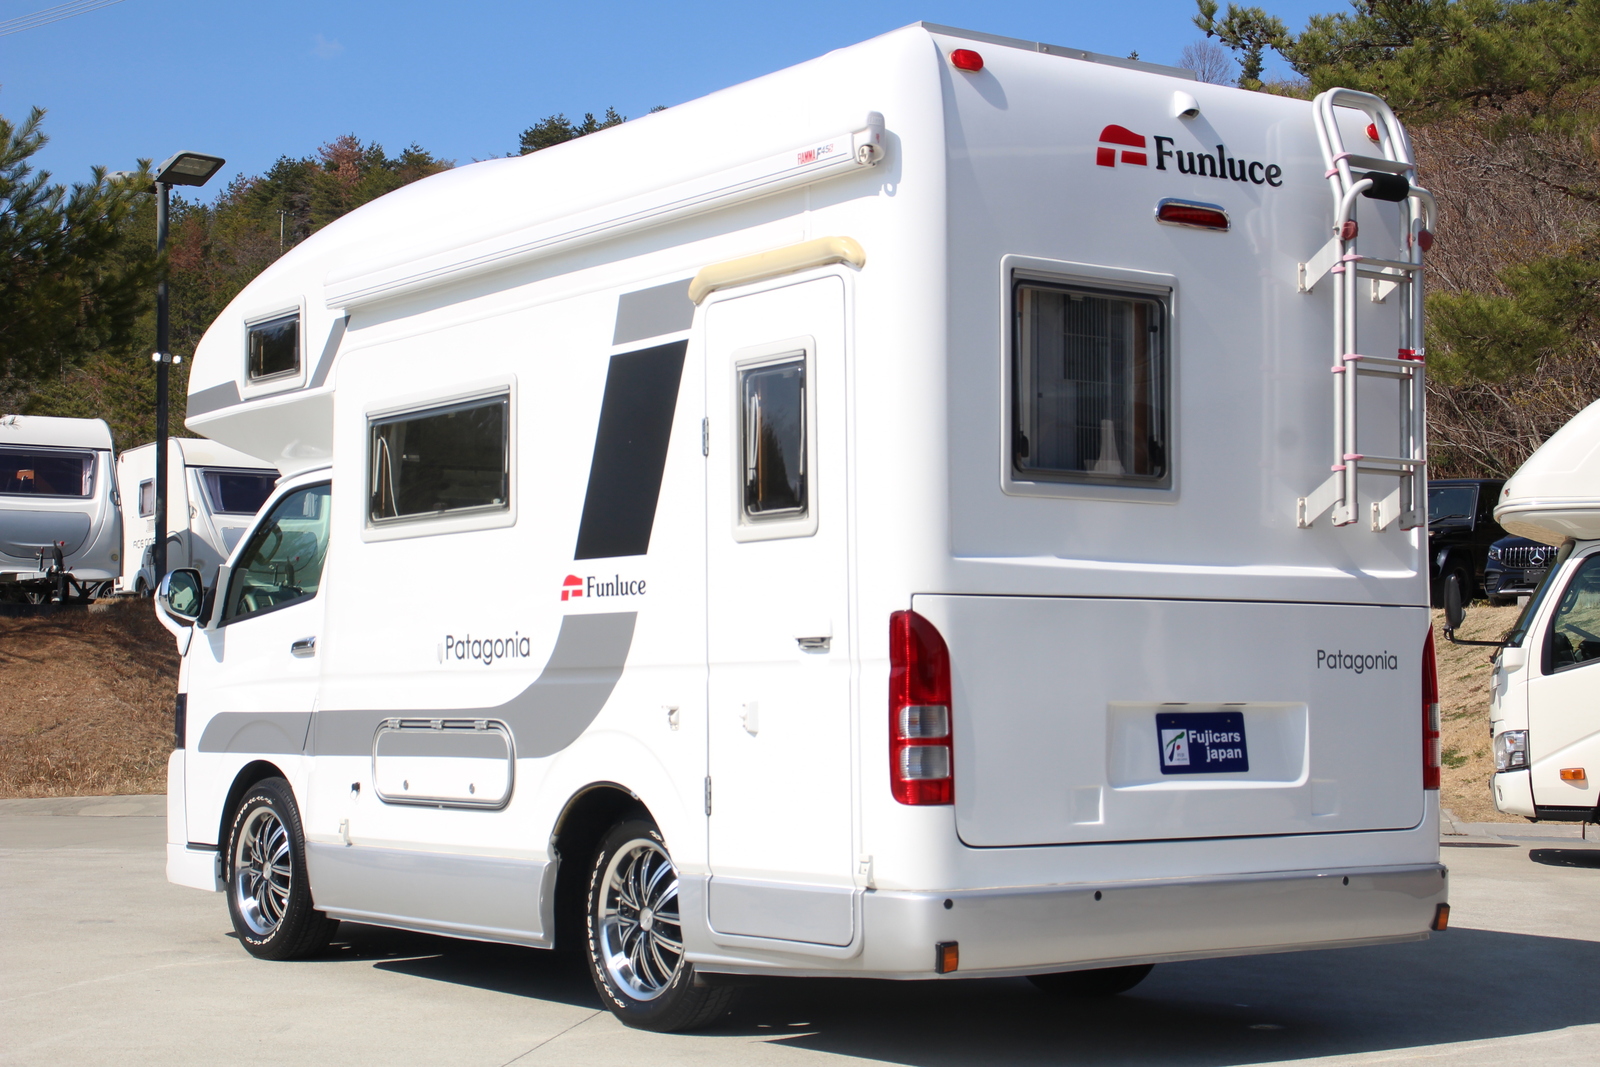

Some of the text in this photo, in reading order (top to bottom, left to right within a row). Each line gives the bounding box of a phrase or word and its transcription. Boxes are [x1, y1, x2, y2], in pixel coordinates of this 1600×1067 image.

[797, 149, 816, 165] FIAMMA
[1153, 135, 1283, 188] Funluce
[586, 574, 646, 598] Funluce
[445, 631, 530, 666] Patagonia
[1316, 649, 1398, 674] Patagonia
[1188, 730, 1241, 746] Fujicars
[1206, 746, 1242, 763] japan
